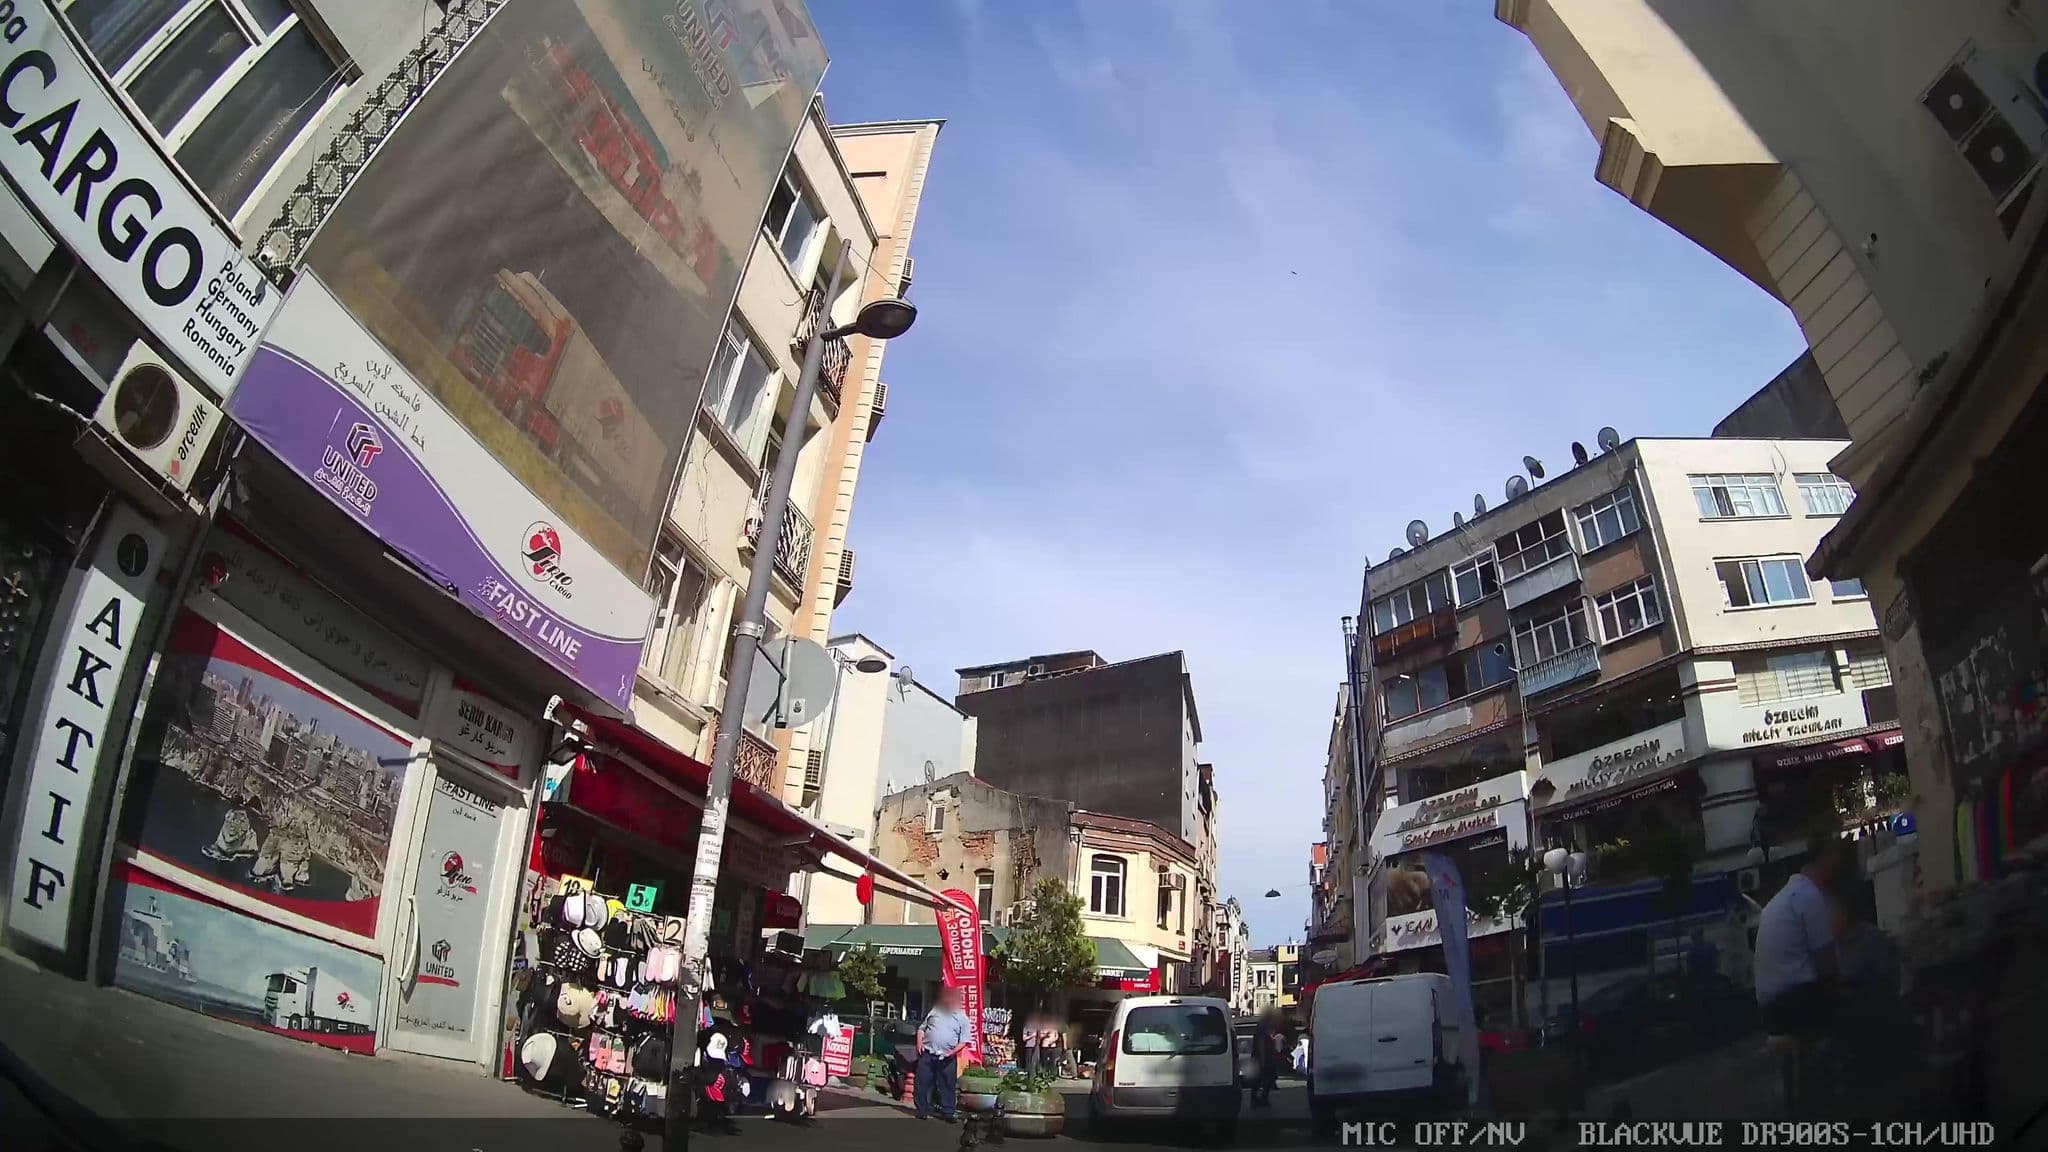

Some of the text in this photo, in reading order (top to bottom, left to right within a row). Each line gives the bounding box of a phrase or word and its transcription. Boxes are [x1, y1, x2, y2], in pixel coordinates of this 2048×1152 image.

[0, 50, 203, 306] CARGO
[207, 279, 260, 338] Germany
[219, 261, 260, 308] Poland
[182, 318, 235, 377] Romania
[195, 298, 247, 357] Hungary
[322, 445, 377, 501] UNITED
[488, 583, 582, 661] FAST LINE
[23, 597, 122, 909] AKTIF
[473, 789, 497, 813] LINE
[425, 961, 455, 979] UNITED
[878, 946, 924, 956] SUPERMARKET
